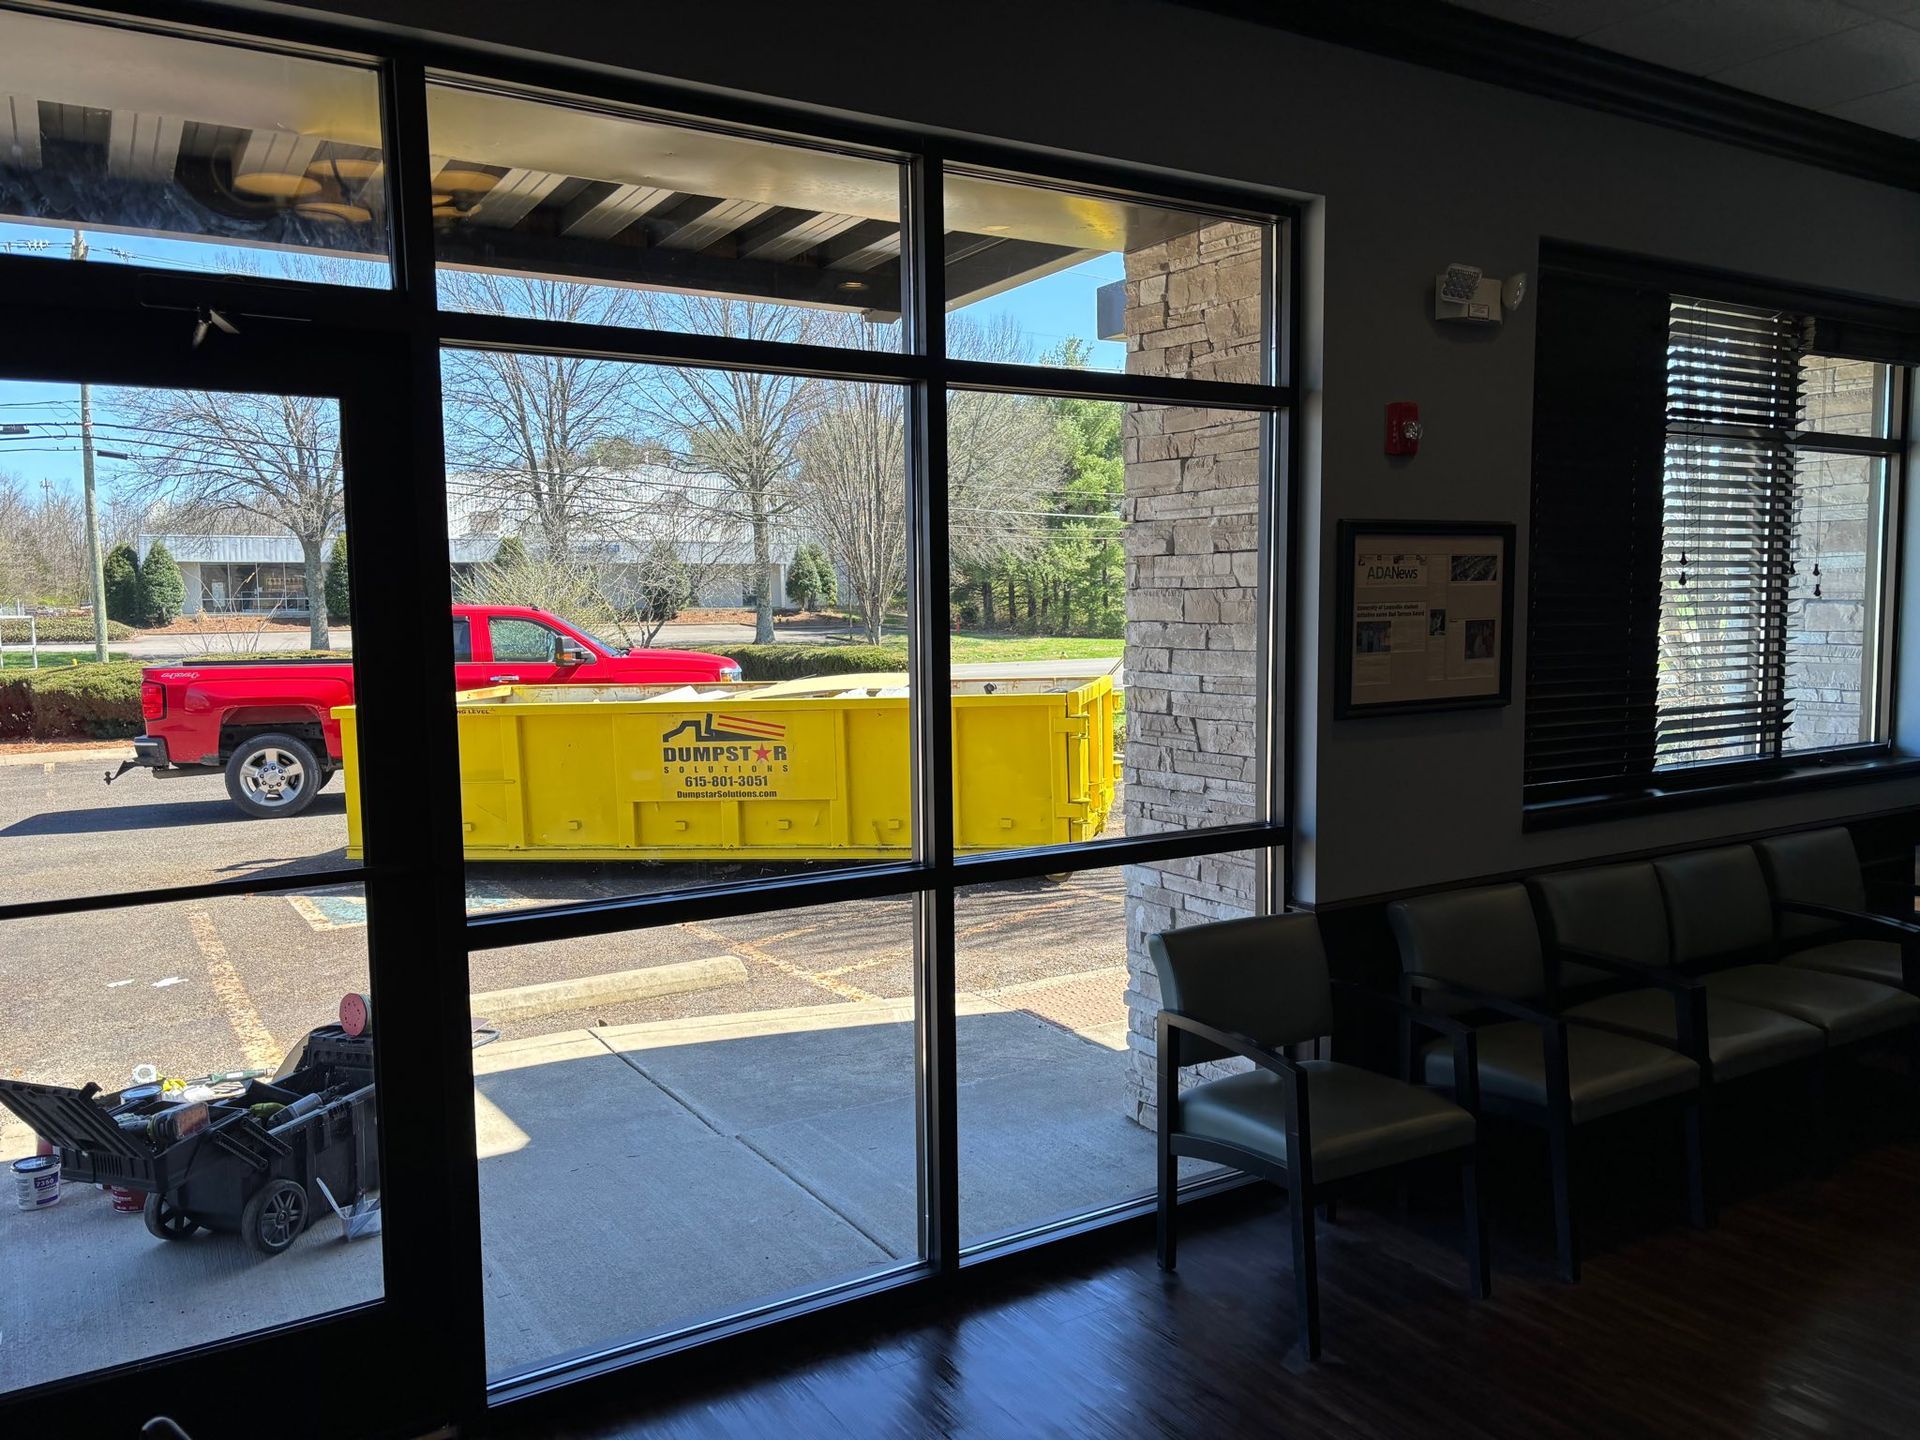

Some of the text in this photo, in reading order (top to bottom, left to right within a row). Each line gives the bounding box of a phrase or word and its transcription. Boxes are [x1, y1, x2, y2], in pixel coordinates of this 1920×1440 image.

[663, 764, 789, 774] SOLUTIONS
[684, 775, 769, 788] 615-801-3051
[676, 790, 778, 799] DumpstarSolutions.com
